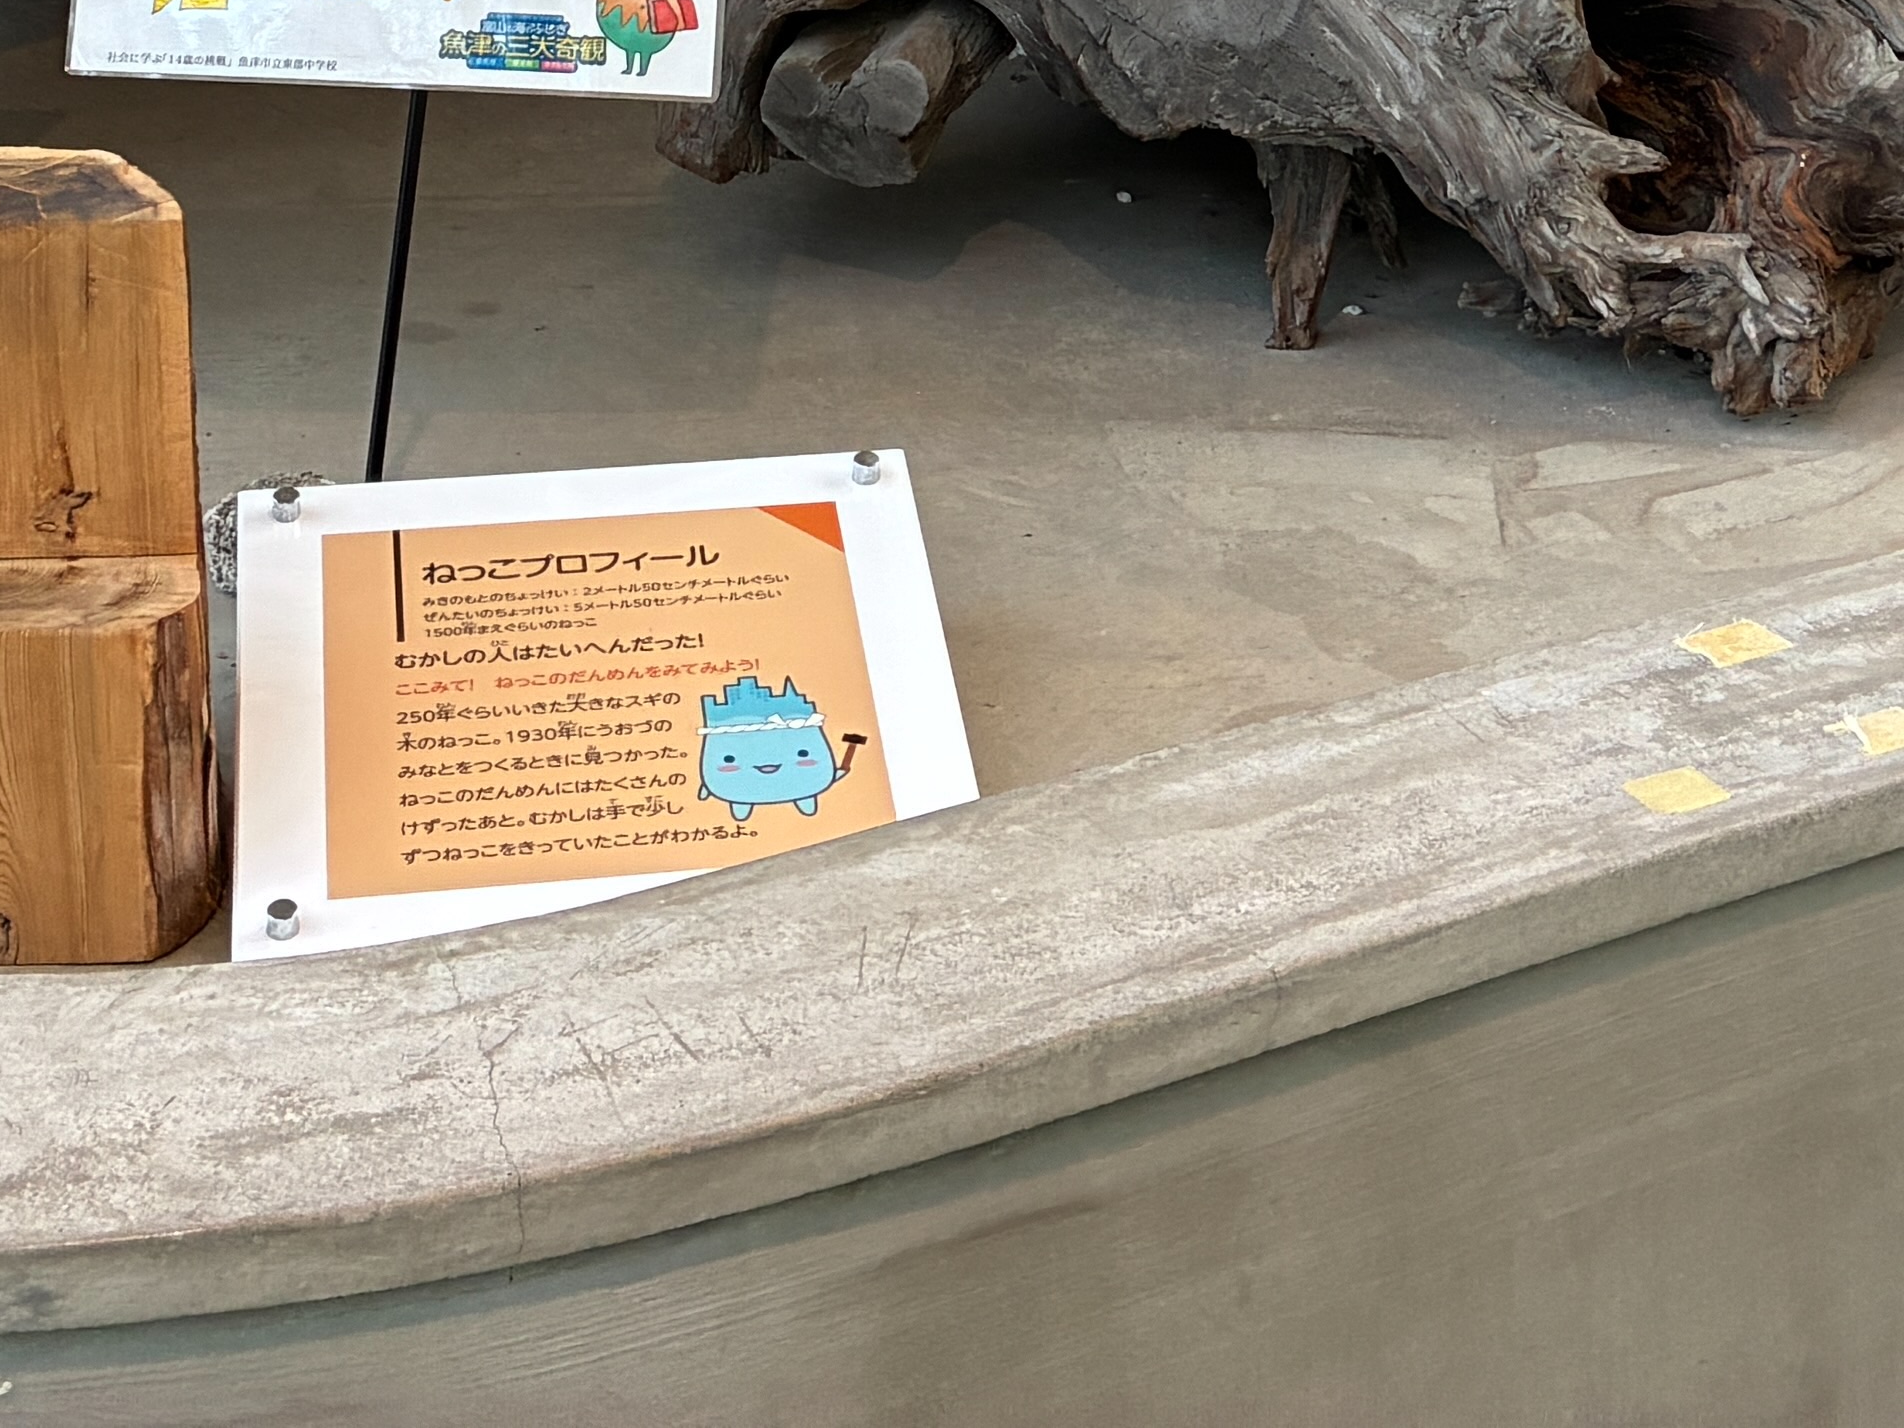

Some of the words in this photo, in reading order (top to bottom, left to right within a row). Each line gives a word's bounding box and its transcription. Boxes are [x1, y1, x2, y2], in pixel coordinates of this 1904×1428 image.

[440, 29, 606, 63] 魚津の三大奇観
[422, 544, 720, 585] ねっこプロフィール
[399, 773, 687, 807] ねっこのだんめんにはたくさんの
